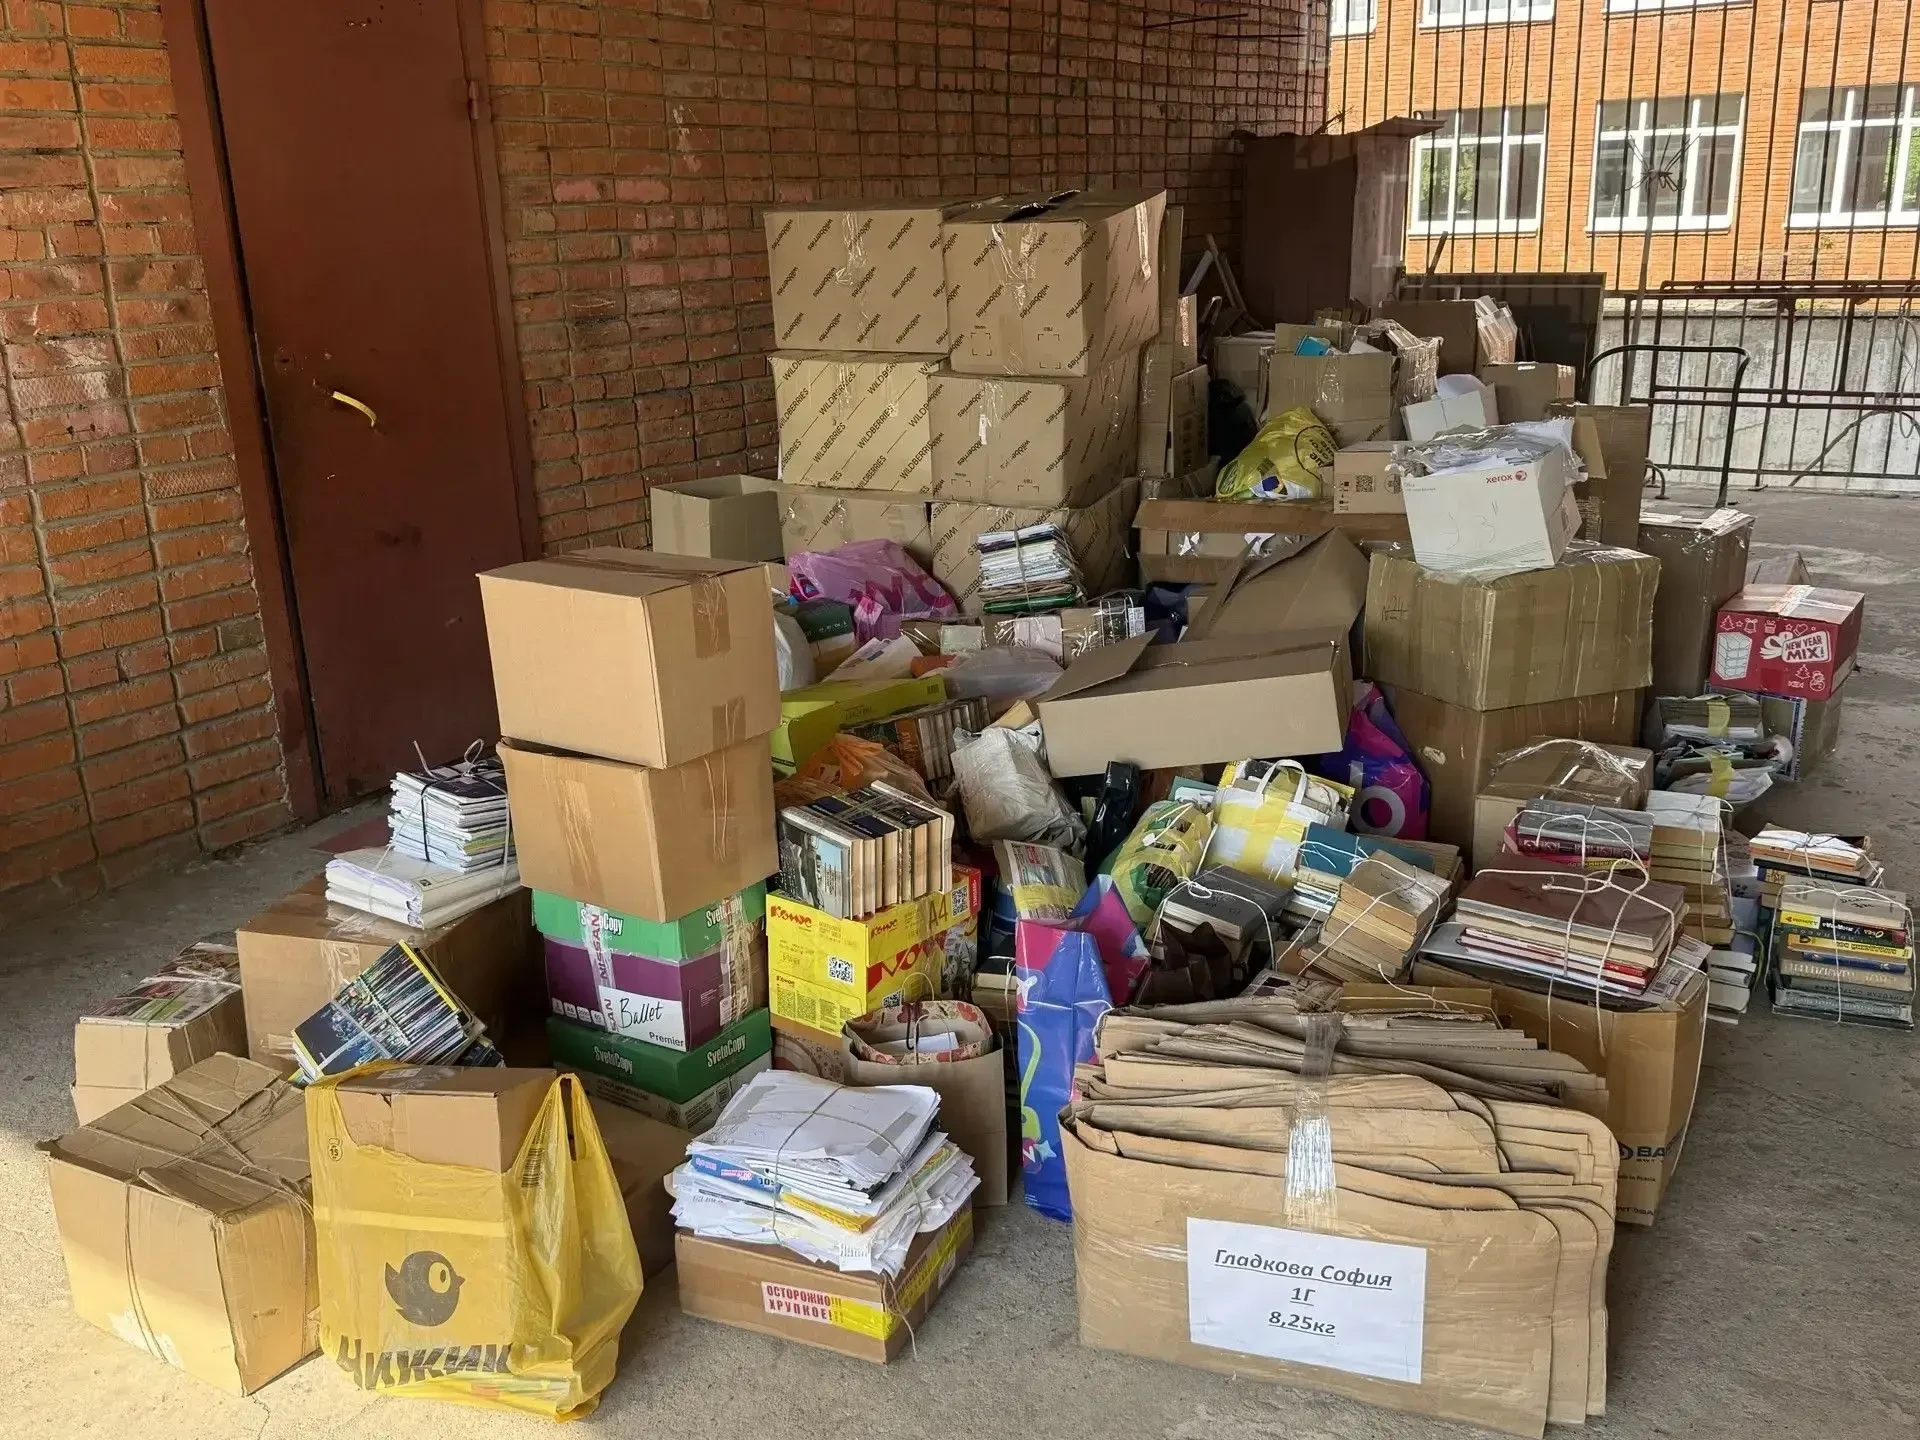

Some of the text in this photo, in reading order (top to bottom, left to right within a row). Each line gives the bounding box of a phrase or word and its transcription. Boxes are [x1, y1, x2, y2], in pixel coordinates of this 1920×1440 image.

[1019, 284, 1050, 318] wildberries
[856, 404, 895, 449] WILDBERRIES
[813, 422, 846, 464] WILDBERRIES
[1486, 474, 1513, 484] xerox
[1785, 634, 1824, 651] NEW YEAR
[1786, 645, 1825, 660] MIX!
[929, 894, 948, 931] A4
[590, 914, 609, 979] NISSAN
[619, 998, 664, 1029] Ballet
[649, 1031, 685, 1047] Premier
[707, 1034, 746, 1068] SvetoCopy
[594, 1046, 633, 1074] SvetoCopy
[1215, 1249, 1392, 1287] Гладкова София
[766, 1285, 842, 1308] ОСТОРОЖНО!!!
[1290, 1287, 1316, 1303] 1Г
[769, 1299, 844, 1324] ХРУПКОЕ!!!
[1268, 1311, 1336, 1335] 8,25кг
